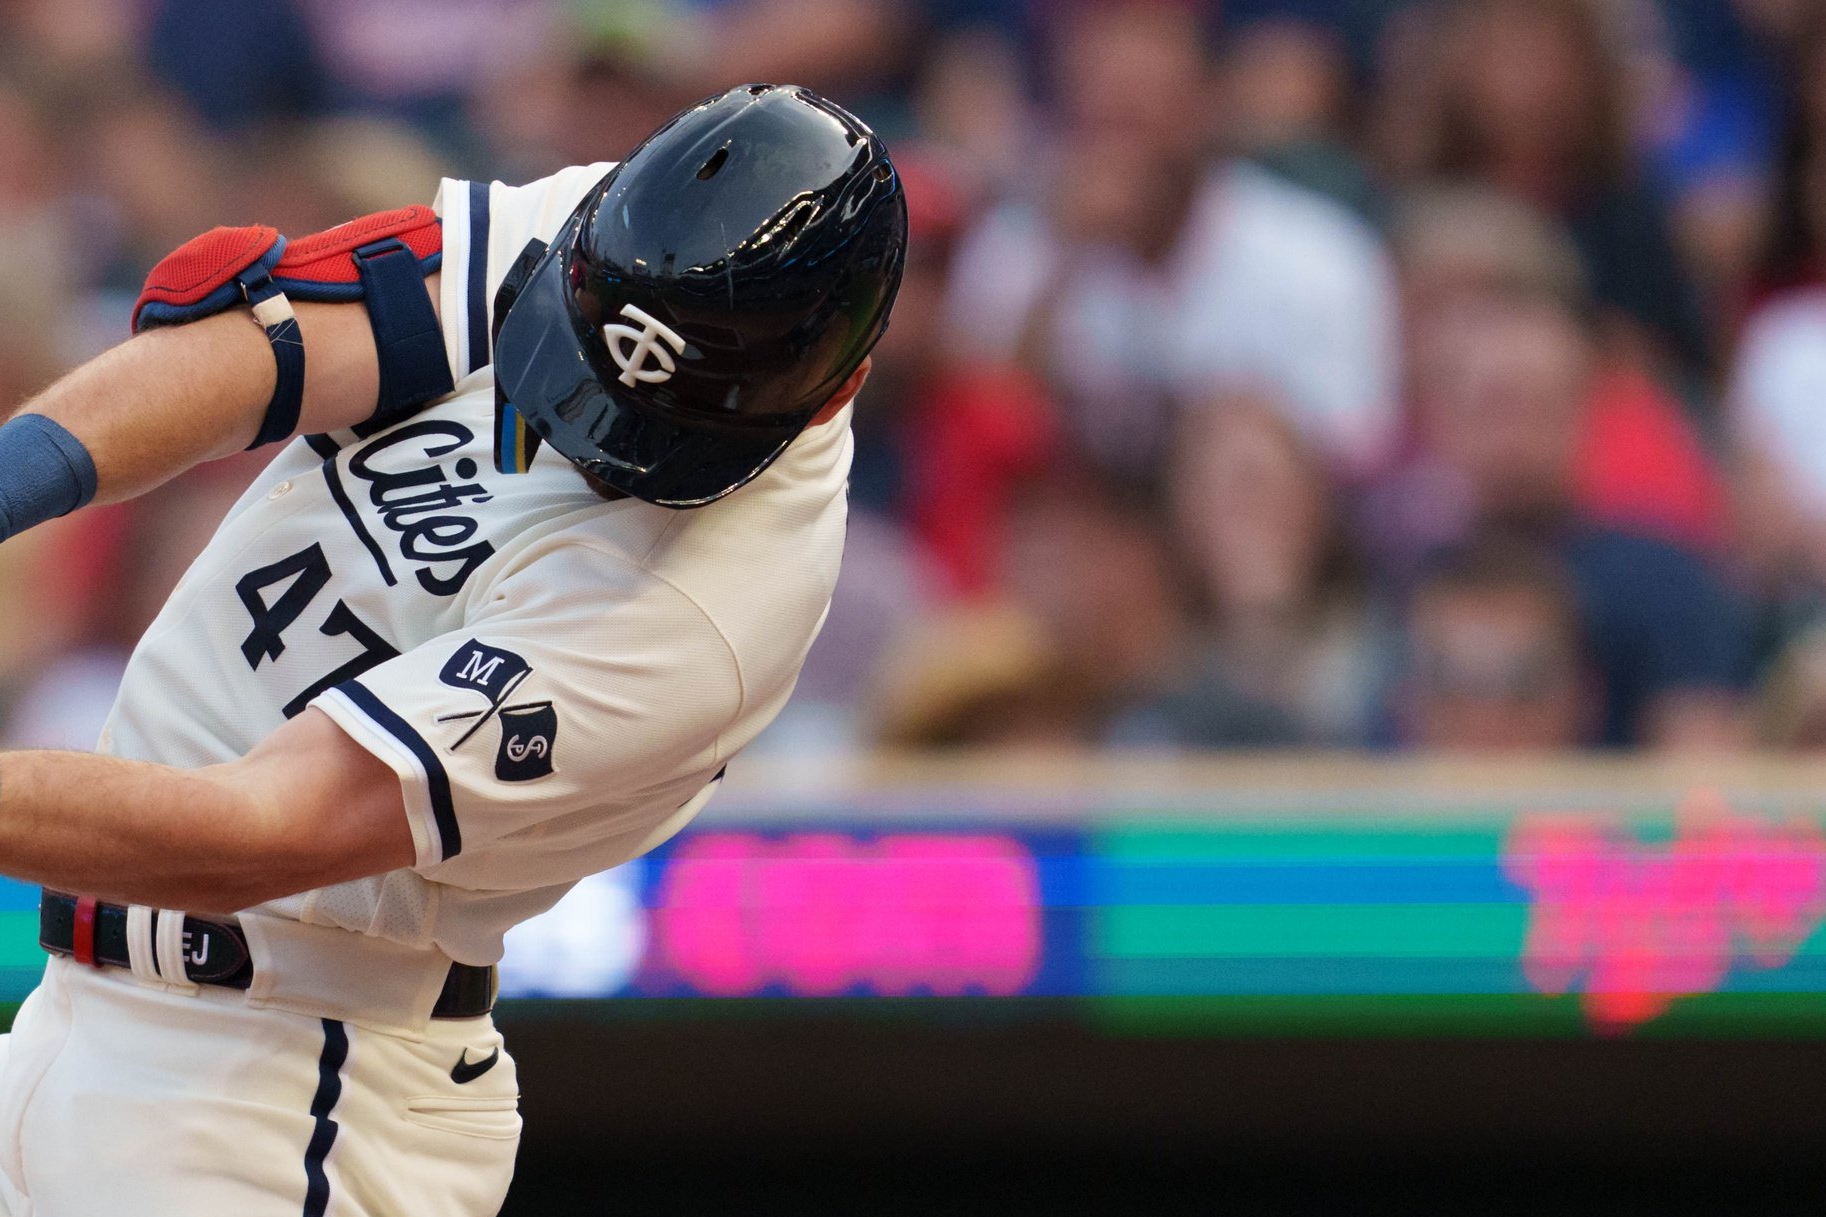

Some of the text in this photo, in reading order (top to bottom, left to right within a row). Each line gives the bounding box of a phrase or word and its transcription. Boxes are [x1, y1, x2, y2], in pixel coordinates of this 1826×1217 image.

[348, 419, 496, 597] Cities
[235, 541, 403, 721] 47
[456, 650, 505, 686] M
